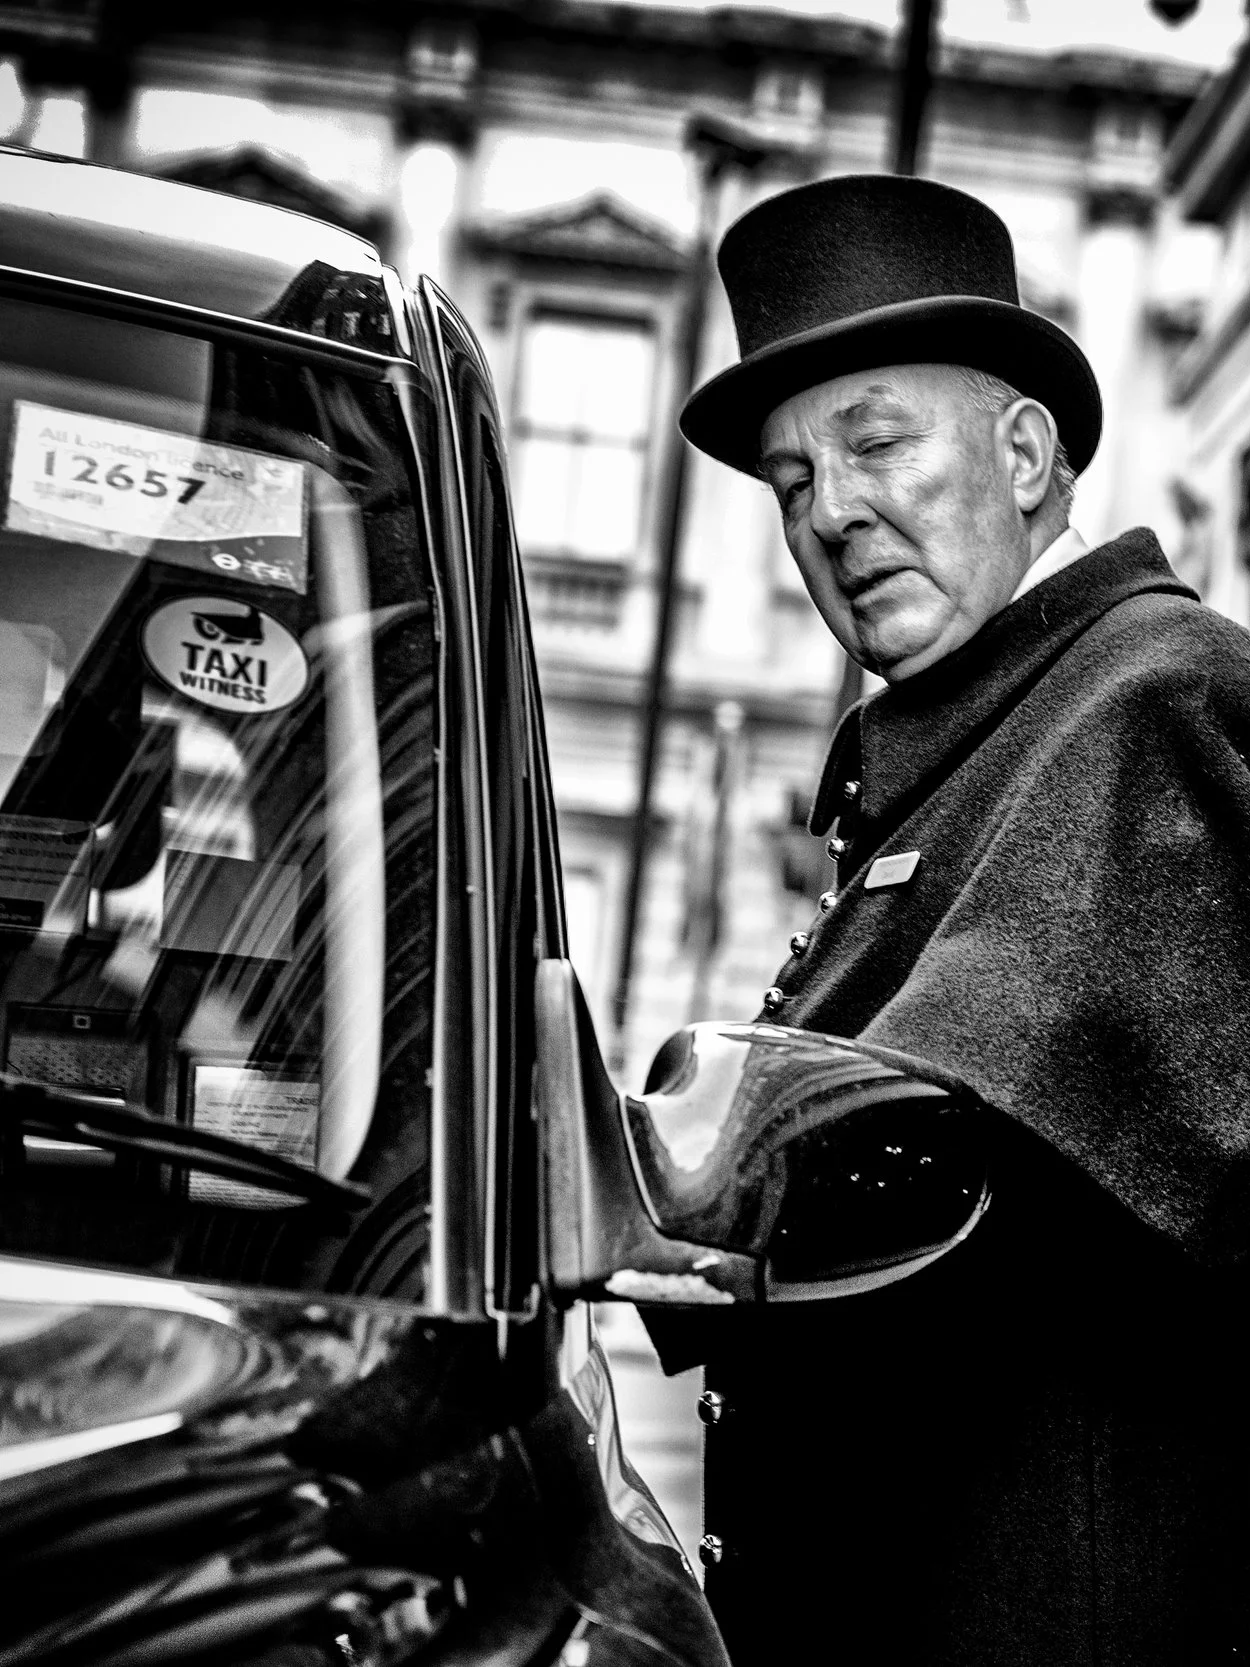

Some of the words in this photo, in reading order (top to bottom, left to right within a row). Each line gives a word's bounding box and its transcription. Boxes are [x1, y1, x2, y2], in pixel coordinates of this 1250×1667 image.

[39, 427, 68, 444] All
[74, 433, 159, 462] London
[44, 451, 206, 505] 12657
[181, 641, 267, 687] TAXI
[180, 671, 266, 704] WITNESS
